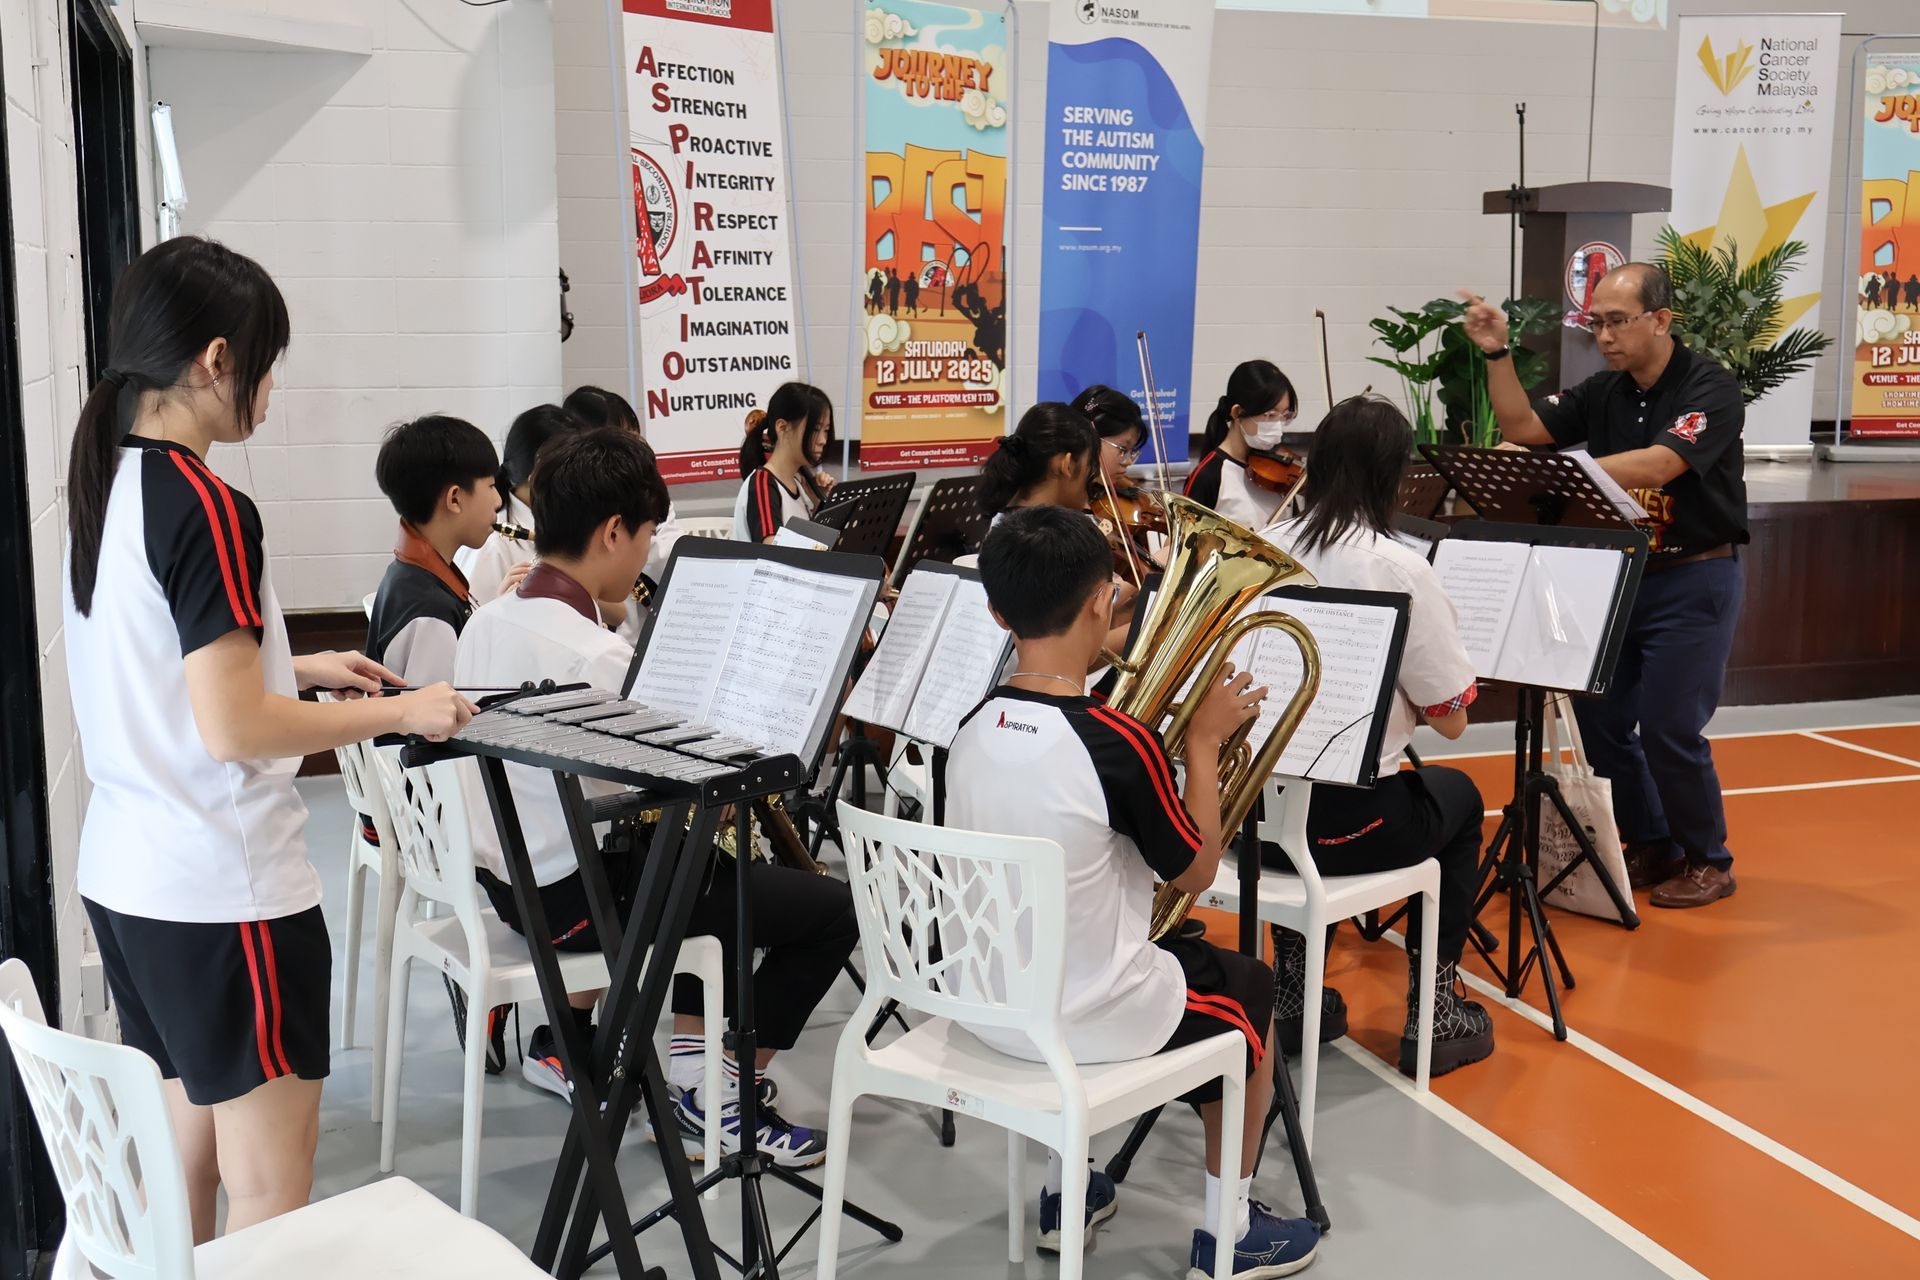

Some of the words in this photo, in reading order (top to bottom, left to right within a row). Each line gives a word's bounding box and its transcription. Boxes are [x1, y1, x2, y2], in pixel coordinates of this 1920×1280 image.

[1101, 7, 1139, 19] NASOM
[1761, 38, 1818, 51] National
[636, 46, 734, 85] AFFECTION
[874, 48, 993, 92] JOURNEY
[1759, 53, 1810, 66] Cancer
[1758, 68, 1810, 82] Society
[903, 73, 930, 98] TO
[930, 77, 965, 102] THE
[1757, 83, 1818, 99] Malaysia
[652, 83, 747, 119] STRENGTH
[1063, 106, 1134, 126] SERVING
[669, 124, 773, 157] PROACTIVE
[1062, 129, 1093, 146] THE
[1096, 131, 1154, 149] AUTISM
[1061, 152, 1159, 171] COMMUNITY
[685, 160, 775, 191] INTEGRITY
[1061, 174, 1106, 191] SINCE
[1110, 177, 1148, 192] 1987
[640, 159, 672, 210] SECONDARY
[657, 212, 672, 249] SCHOOL
[694, 202, 778, 231] RESPECT
[692, 241, 773, 269] AFFINITY
[686, 276, 786, 305] TOLERANCE
[680, 314, 788, 342] IMAGINATION
[904, 341, 967, 358] SATURDAY
[1872, 346, 1893, 368] 12
[663, 351, 791, 380] OUTSTANDING
[877, 360, 895, 385] 12
[900, 360, 942, 381] JULY
[948, 360, 992, 383] 2025
[1870, 374, 1898, 383] VENUE
[647, 388, 756, 419] NURTURING
[875, 395, 902, 405] VENUE
[908, 394, 921, 404] THE
[691, 460, 702, 468] Get
[703, 458, 735, 467] Connected
[1325, 610, 1354, 618] DISTANCE
[996, 711, 1038, 734] ASPIRATION
